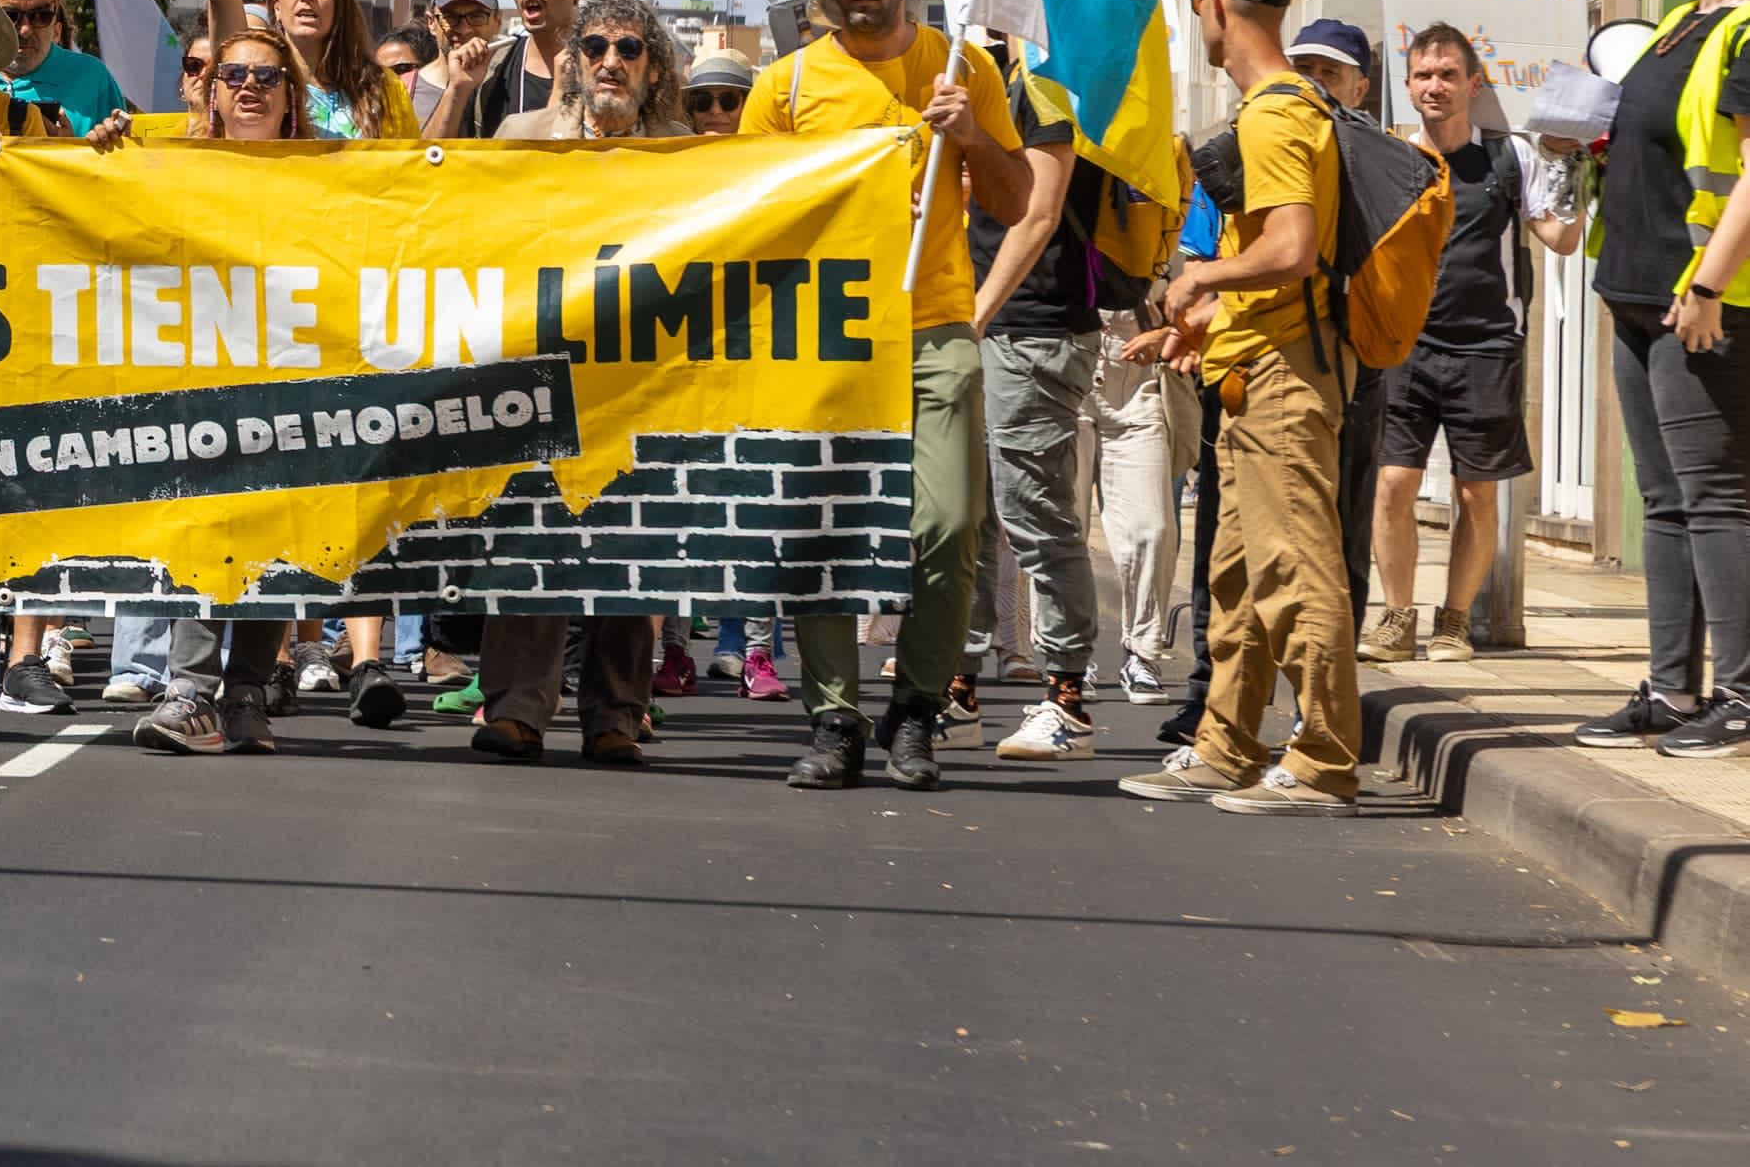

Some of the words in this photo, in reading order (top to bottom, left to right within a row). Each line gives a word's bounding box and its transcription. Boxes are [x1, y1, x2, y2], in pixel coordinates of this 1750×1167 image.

[36, 263, 320, 370] TIENE
[359, 266, 506, 374] UN
[535, 243, 873, 368] LÍMITE
[24, 421, 219, 475] CAMBIO
[236, 412, 304, 457] DE
[312, 386, 554, 451] MODELO!
